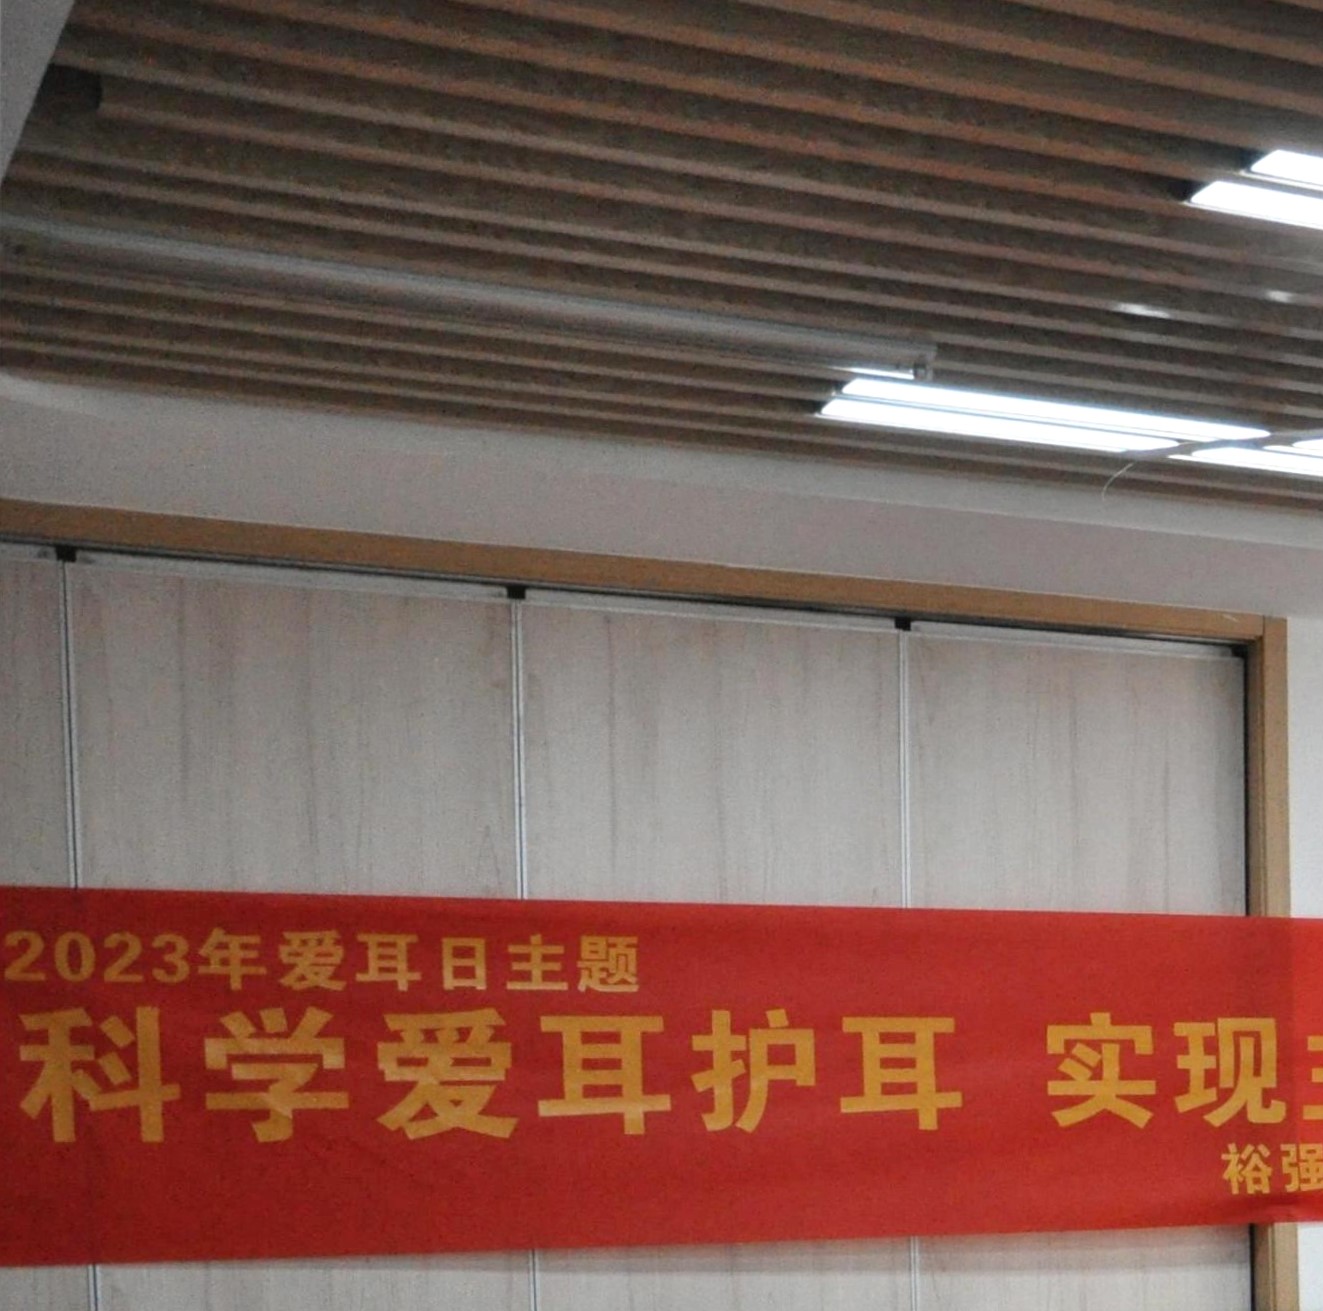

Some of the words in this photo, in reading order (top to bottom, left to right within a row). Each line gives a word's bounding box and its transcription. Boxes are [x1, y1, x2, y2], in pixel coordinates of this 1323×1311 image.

[4, 927, 640, 994] 2023年爱耳日主题
[19, 1006, 964, 1144] 科学爱耳护耳
